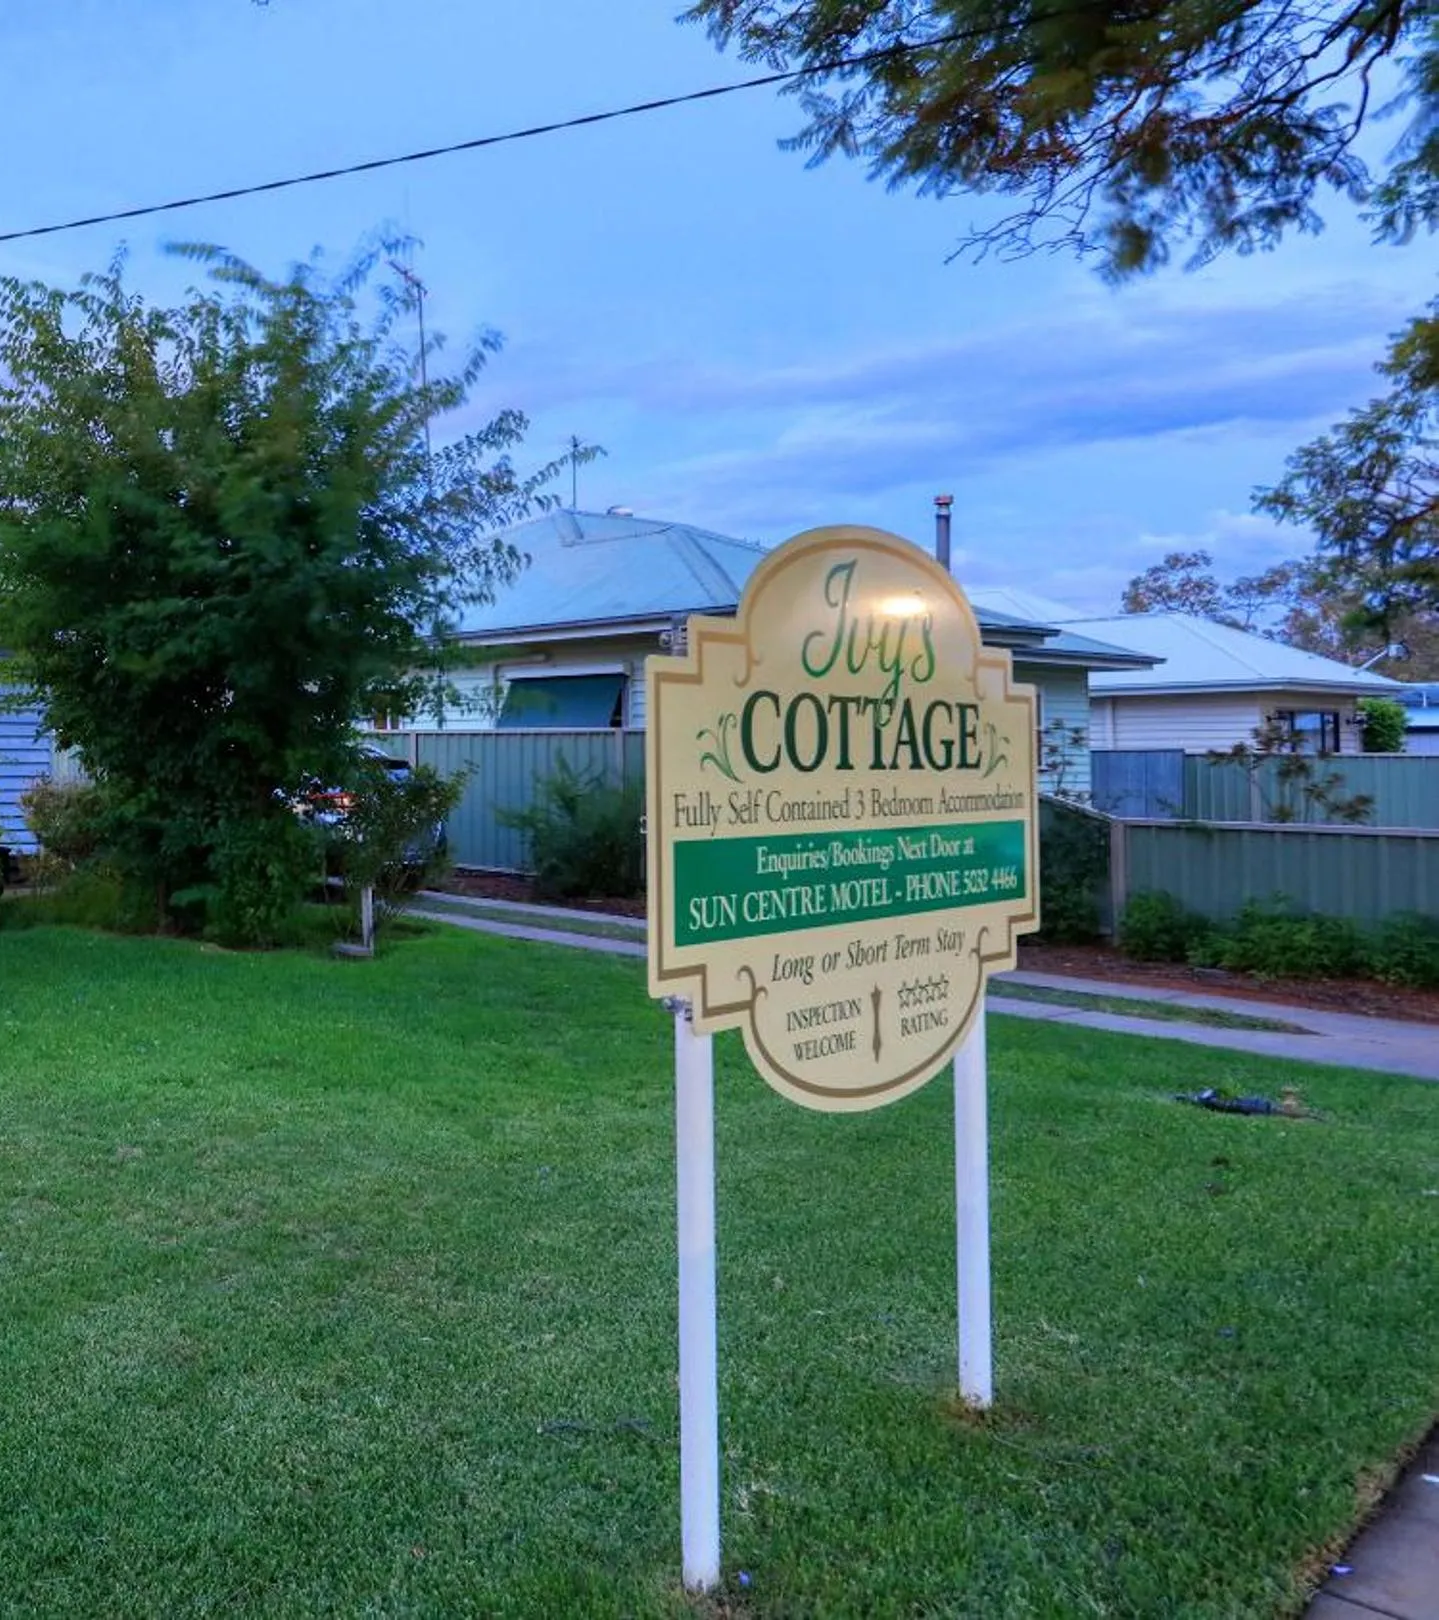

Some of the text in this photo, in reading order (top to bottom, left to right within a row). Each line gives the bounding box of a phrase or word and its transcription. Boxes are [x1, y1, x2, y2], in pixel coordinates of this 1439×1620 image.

[740, 689, 982, 773] COTTAGE
[673, 791, 722, 836] Fully
[728, 789, 763, 825] Self
[766, 787, 851, 823] Contained
[855, 789, 865, 820] 3
[871, 787, 934, 817] Bedroom
[897, 835, 928, 861] Next
[930, 833, 961, 857] Door
[963, 837, 974, 856] at
[689, 894, 738, 931] SUN
[743, 884, 827, 923] CENTRE
[830, 878, 893, 913] MOTEL
[905, 870, 960, 902] PHONE
[771, 927, 966, 985] Long or Short Term Stay
[786, 998, 862, 1032] INSPECTION
[900, 1008, 949, 1038] RATING
[793, 1030, 857, 1061] WELCOME
